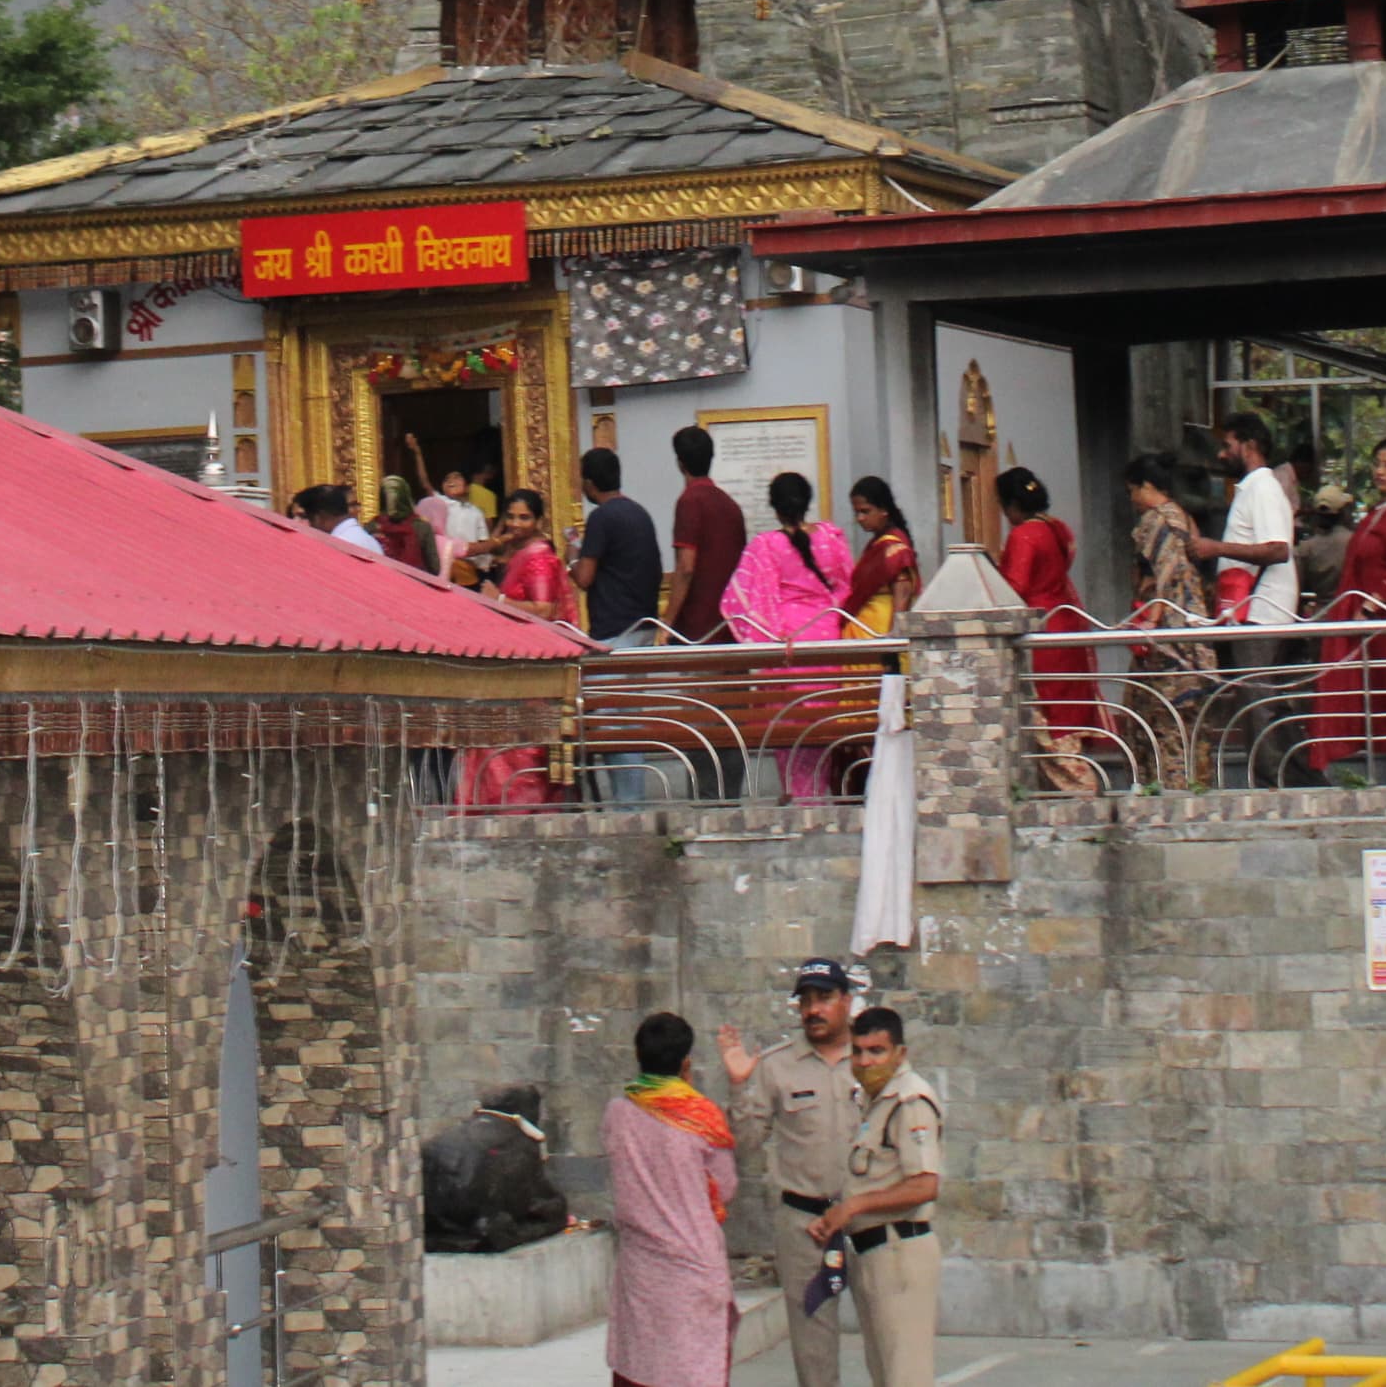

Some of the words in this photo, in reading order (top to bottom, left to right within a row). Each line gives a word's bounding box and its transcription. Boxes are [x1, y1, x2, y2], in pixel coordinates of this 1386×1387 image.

[253, 248, 292, 281] जय
[305, 230, 333, 278] श्री
[344, 226, 403, 276] काशी
[416, 225, 512, 272] विश्वनाथ
